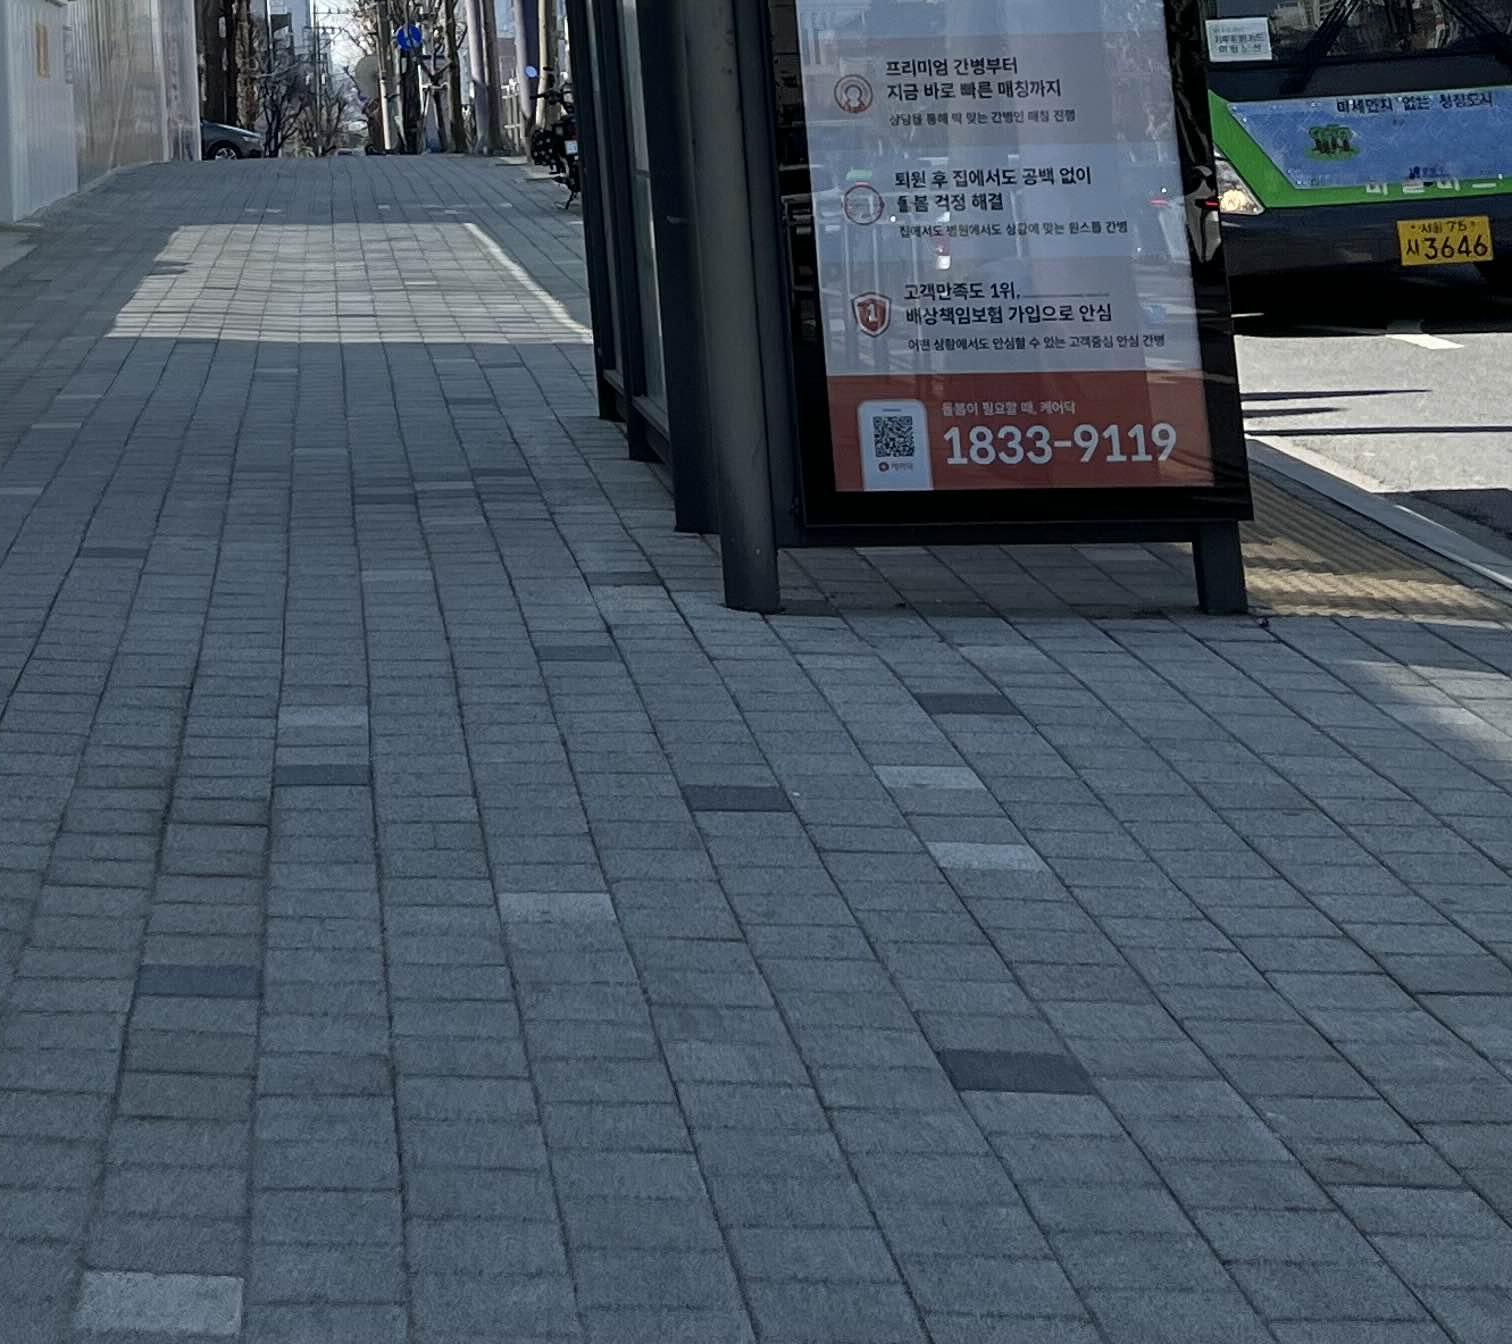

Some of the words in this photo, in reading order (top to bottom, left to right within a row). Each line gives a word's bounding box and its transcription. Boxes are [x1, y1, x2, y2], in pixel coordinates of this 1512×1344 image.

[885, 58, 948, 78] 프리미엄
[953, 56, 1019, 77] 간병부터
[887, 82, 919, 102] 지금
[924, 81, 957, 100] 바로
[960, 80, 993, 99] 빠른
[997, 78, 1062, 99] 매칭까지
[895, 169, 926, 189] 퇴원
[931, 170, 948, 189] 후
[952, 168, 1017, 188] 집에서도
[1022, 166, 1055, 186] 공백
[1059, 165, 1092, 185] 없이
[935, 193, 966, 212] 걱정
[971, 192, 1004, 211] 해결
[1423, 234, 1489, 260] 3646
[904, 282, 986, 301] 고객만족도
[906, 305, 1004, 326] 배상책임보험
[1008, 304, 1076, 324] 가입으로
[1079, 303, 1112, 322] 안심
[1029, 336, 1041, 349] 수
[1043, 335, 1066, 349] 있는
[1116, 333, 1140, 348] 안심
[1040, 399, 1077, 416] 케어닥
[943, 422, 1178, 466] 1833-9119
